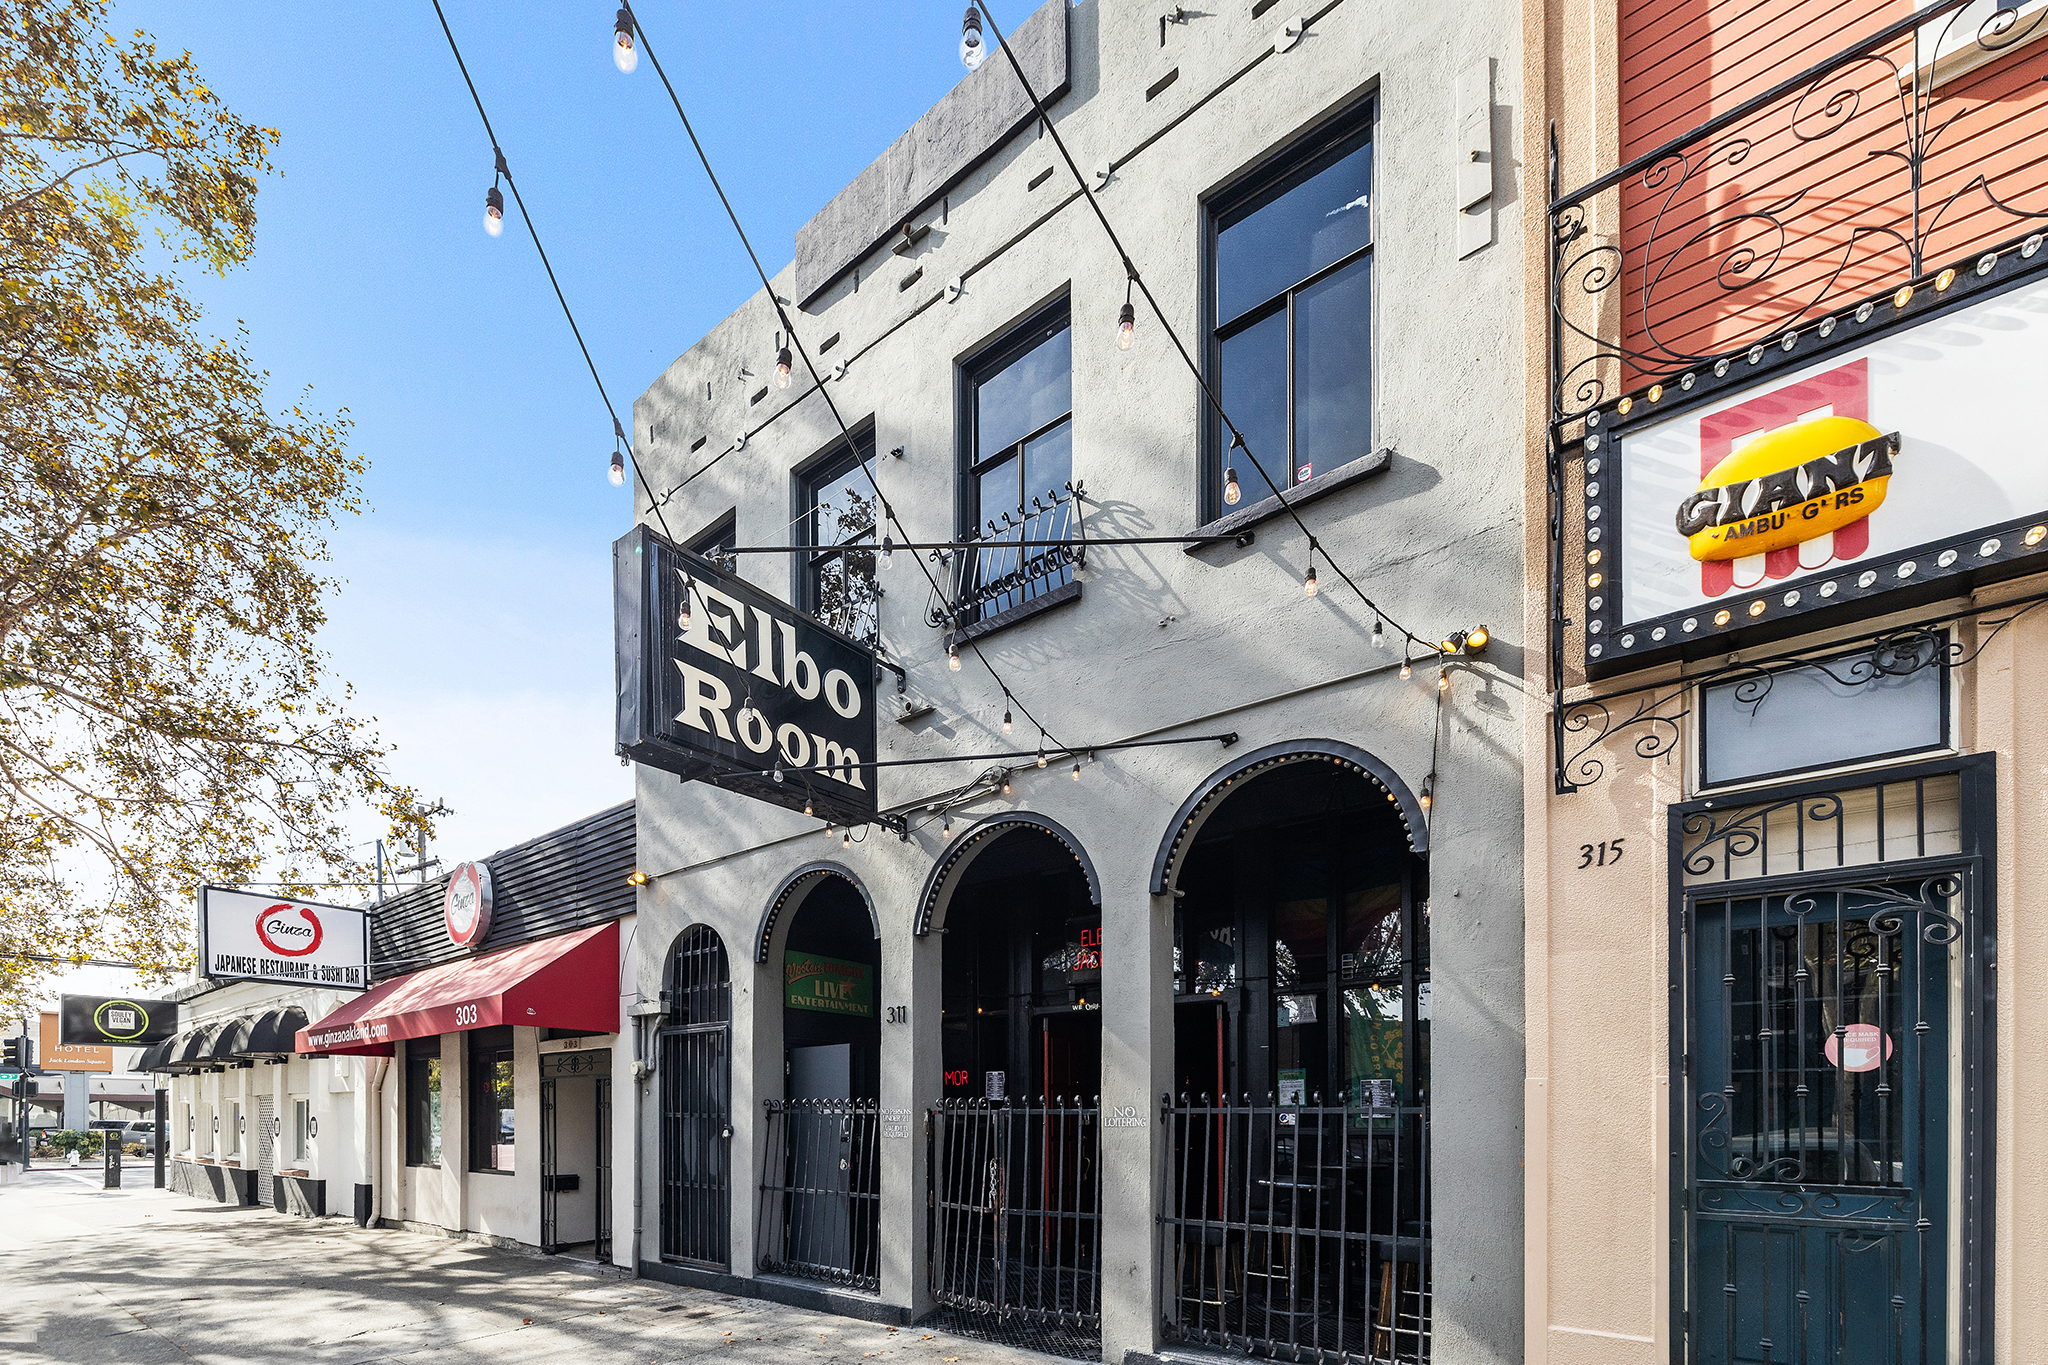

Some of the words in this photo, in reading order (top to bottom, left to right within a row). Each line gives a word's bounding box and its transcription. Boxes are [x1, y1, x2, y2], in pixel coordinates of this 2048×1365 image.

[1675, 431, 1902, 537] GIANT
[1712, 487, 1865, 543] AMBUGRS
[675, 568, 862, 719] Elbo
[672, 657, 866, 791] Room
[1578, 838, 1625, 869] 315
[450, 891, 475, 916] Ginza
[266, 919, 314, 938] Ginza
[215, 953, 257, 975] JAPANESE
[260, 958, 310, 980] RESTAURANT
[312, 963, 319, 980] &
[321, 964, 343, 983] SUSHI
[345, 966, 360, 984] BAR
[814, 979, 848, 1001] LIVE
[110, 1010, 132, 1018] SOULEY
[455, 1003, 478, 1026] 303
[791, 994, 869, 1014] ENTERTAINMENT
[886, 1005, 907, 1024] 311
[111, 1016, 132, 1024] VEGAN
[307, 1022, 388, 1049] www.ginzaoakland.com
[563, 1040, 578, 1049] 303
[54, 1045, 100, 1054] HOTEL
[882, 1114, 901, 1122] UNDER
[1104, 1117, 1147, 1127] LOITERING
[1113, 1105, 1136, 1118] NO
